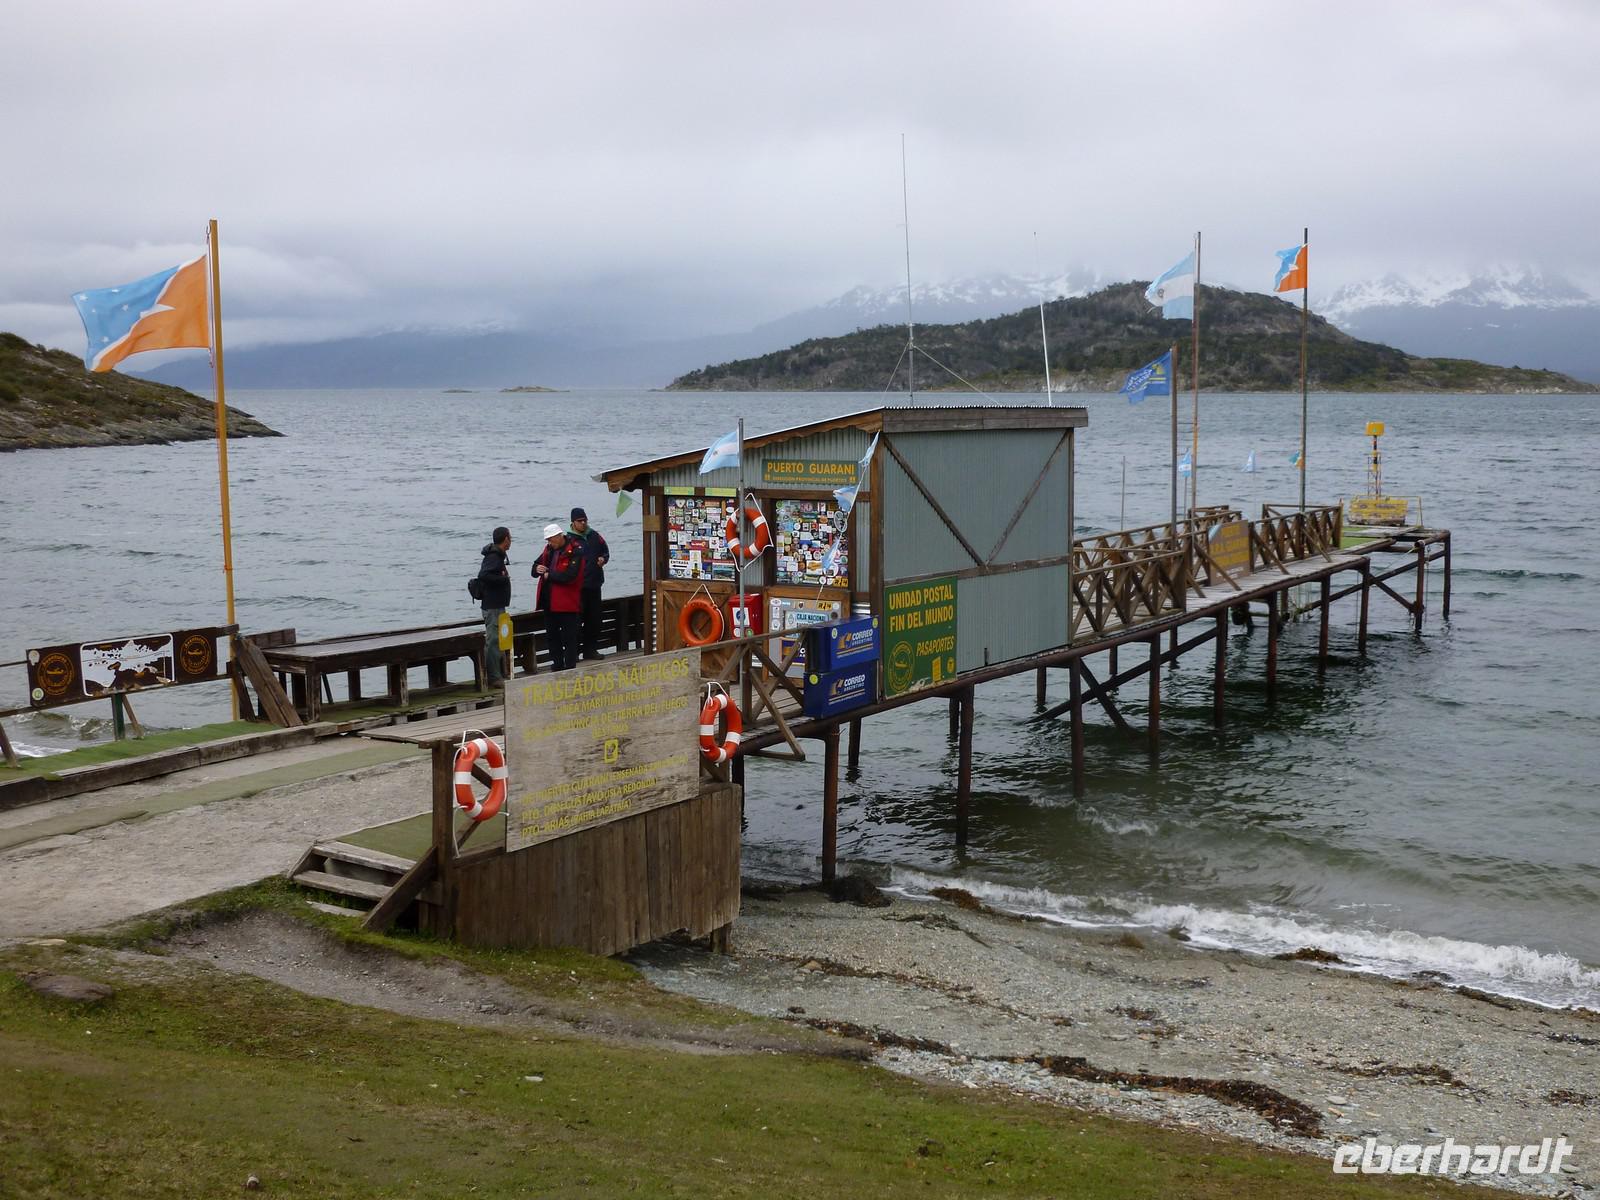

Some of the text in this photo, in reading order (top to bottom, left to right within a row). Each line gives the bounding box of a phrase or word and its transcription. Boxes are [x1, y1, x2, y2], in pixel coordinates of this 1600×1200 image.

[767, 462, 855, 475] PUERTO GUARANI
[889, 584, 954, 610] UNIDAD POSTAL
[890, 604, 954, 633] FIN DEL MUNDO
[852, 628, 873, 641] CORREO
[916, 636, 955, 657] PASAPORTES
[524, 656, 689, 705] TRASLADOS NÁUTICOS
[844, 674, 866, 687] CORREO
